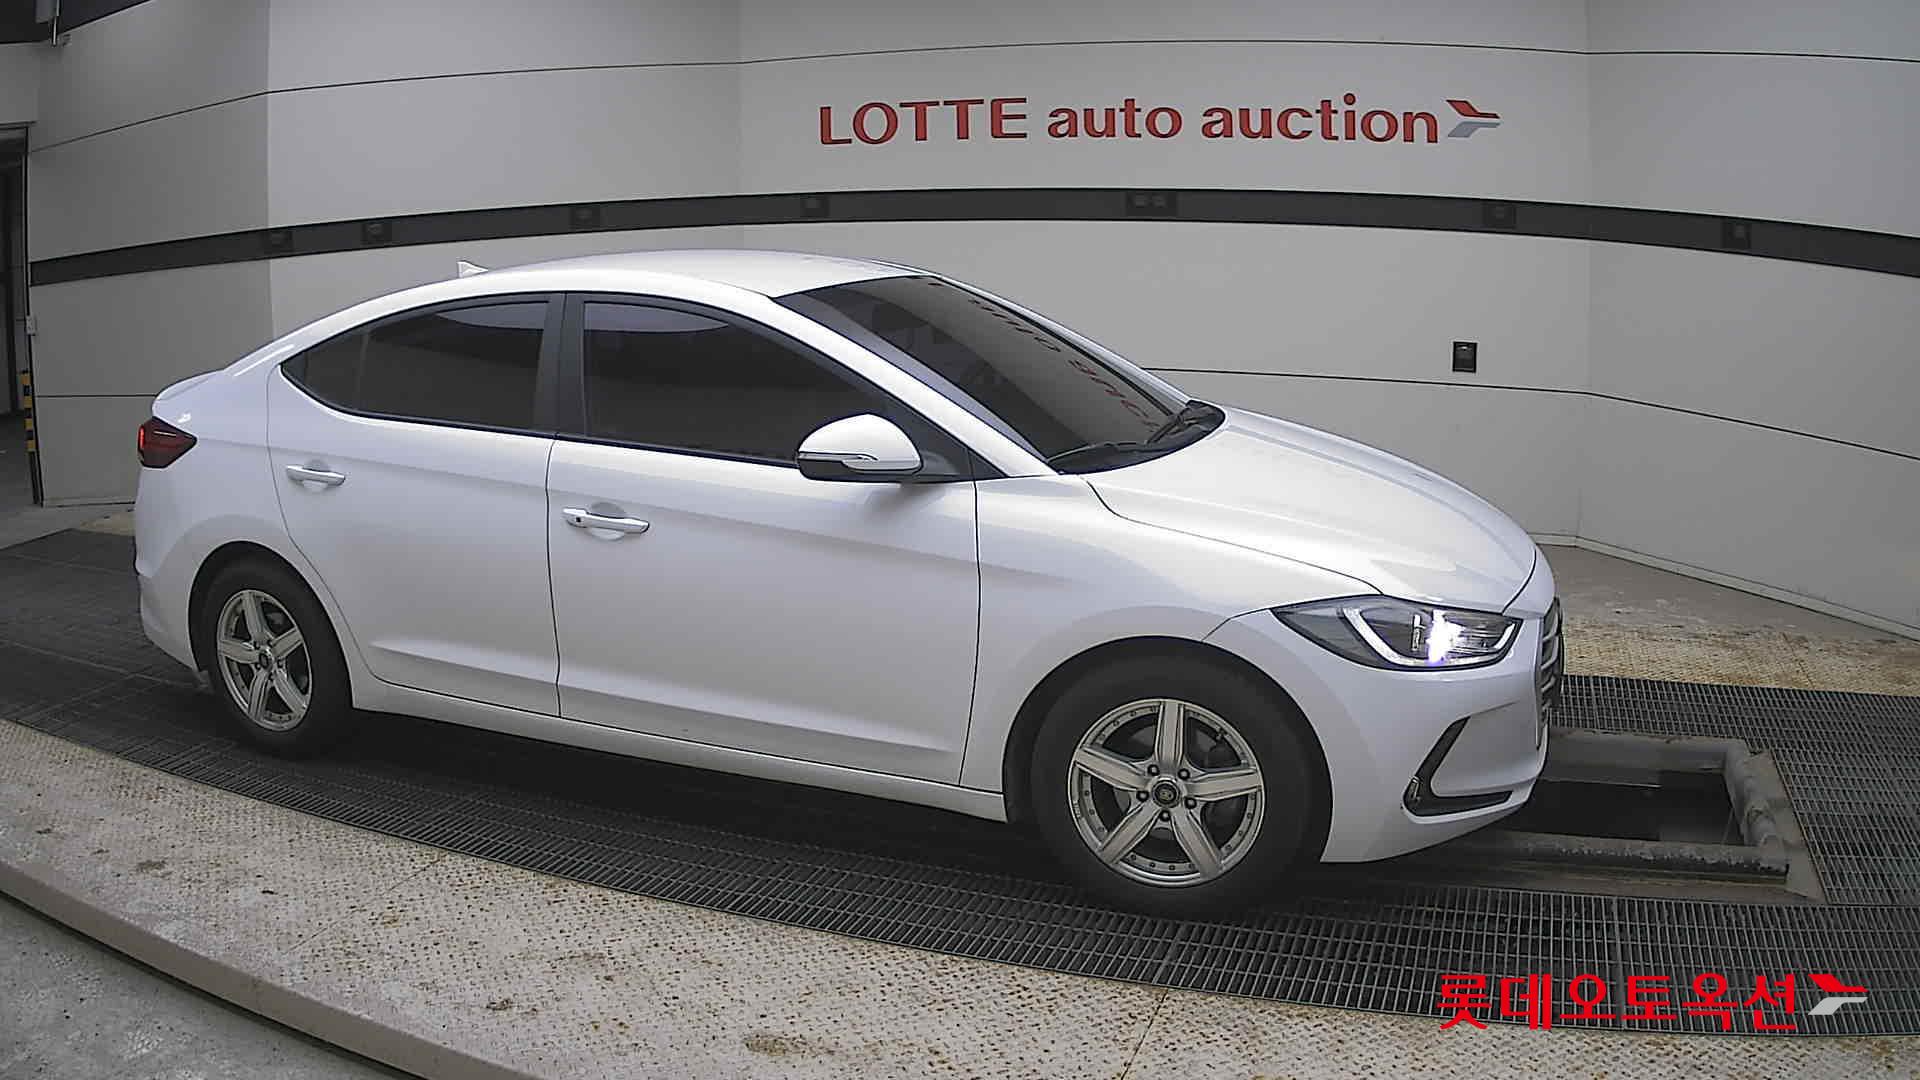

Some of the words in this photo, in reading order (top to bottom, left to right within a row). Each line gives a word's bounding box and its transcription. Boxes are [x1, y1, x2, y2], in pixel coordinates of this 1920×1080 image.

[820, 97, 1027, 145] LOTTE
[1047, 98, 1184, 140] auto
[1201, 94, 1440, 143] auction
